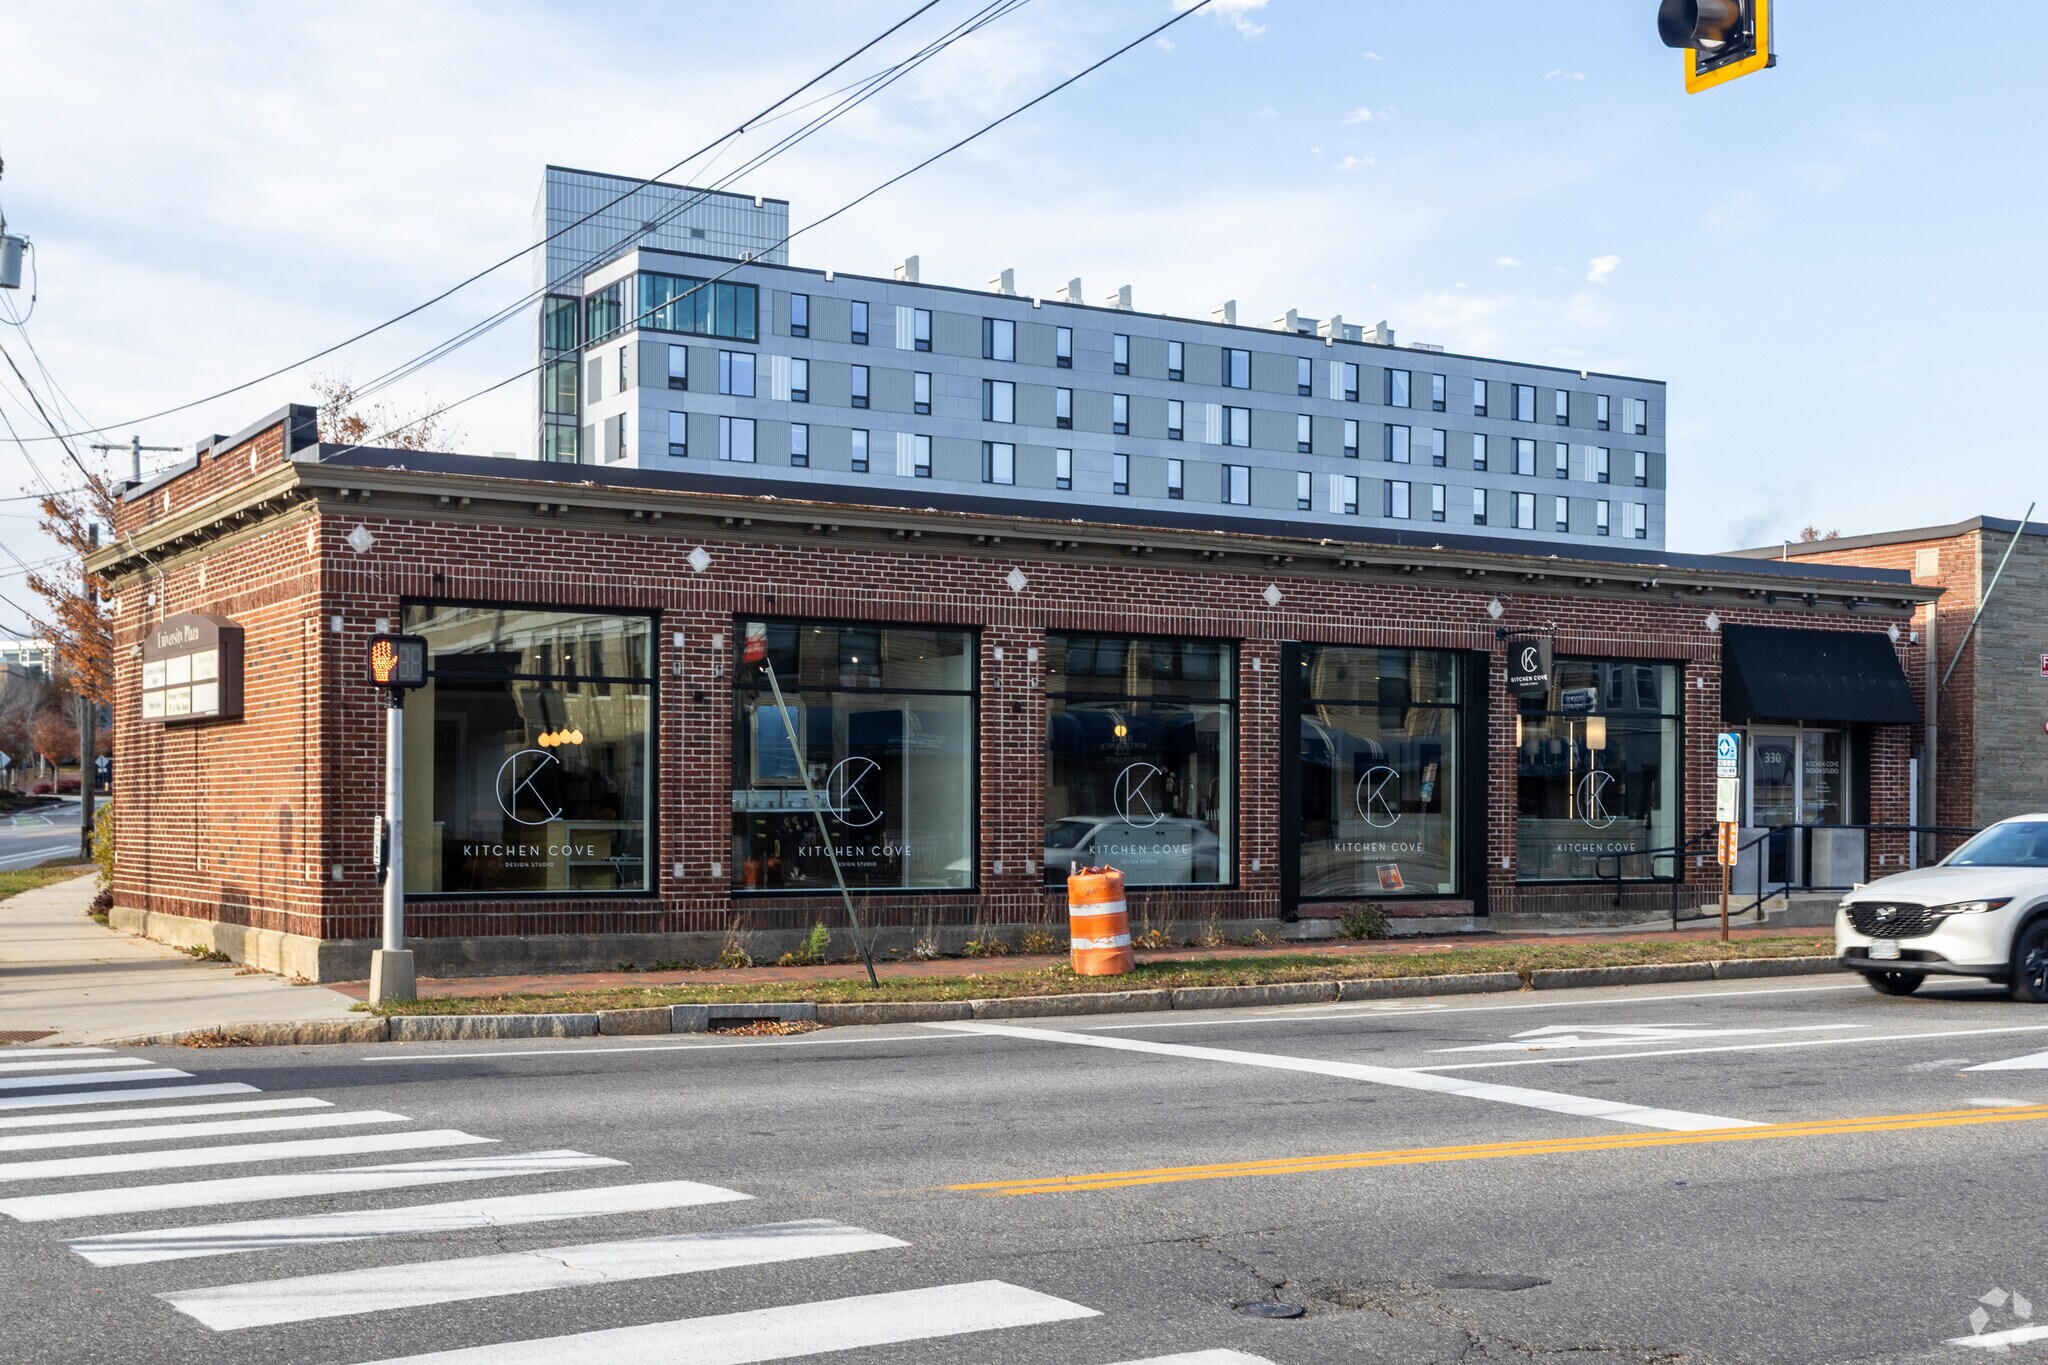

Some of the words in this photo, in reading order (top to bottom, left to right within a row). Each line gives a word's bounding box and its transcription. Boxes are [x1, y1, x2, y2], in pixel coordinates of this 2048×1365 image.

[157, 627, 183, 649] University
[184, 624, 199, 643] Plaza
[1511, 675, 1533, 683] KITCHEN
[1764, 752, 1781, 764] 330
[1805, 760, 1825, 768] KITCHEN
[1826, 760, 1839, 768] COVE
[1823, 767, 1839, 775] STUDIO
[463, 845, 539, 857] KITCHEN
[548, 845, 595, 857] COVE
[798, 846, 865, 857] KITCHEN
[871, 846, 912, 857] COVE
[1089, 844, 1146, 855] KITCHEN
[1152, 844, 1188, 854] COVE
[1334, 842, 1386, 852] KITCHEN
[1391, 842, 1423, 852] COVE
[1557, 843, 1603, 852] KITCHEN
[1607, 843, 1636, 852] COVE
